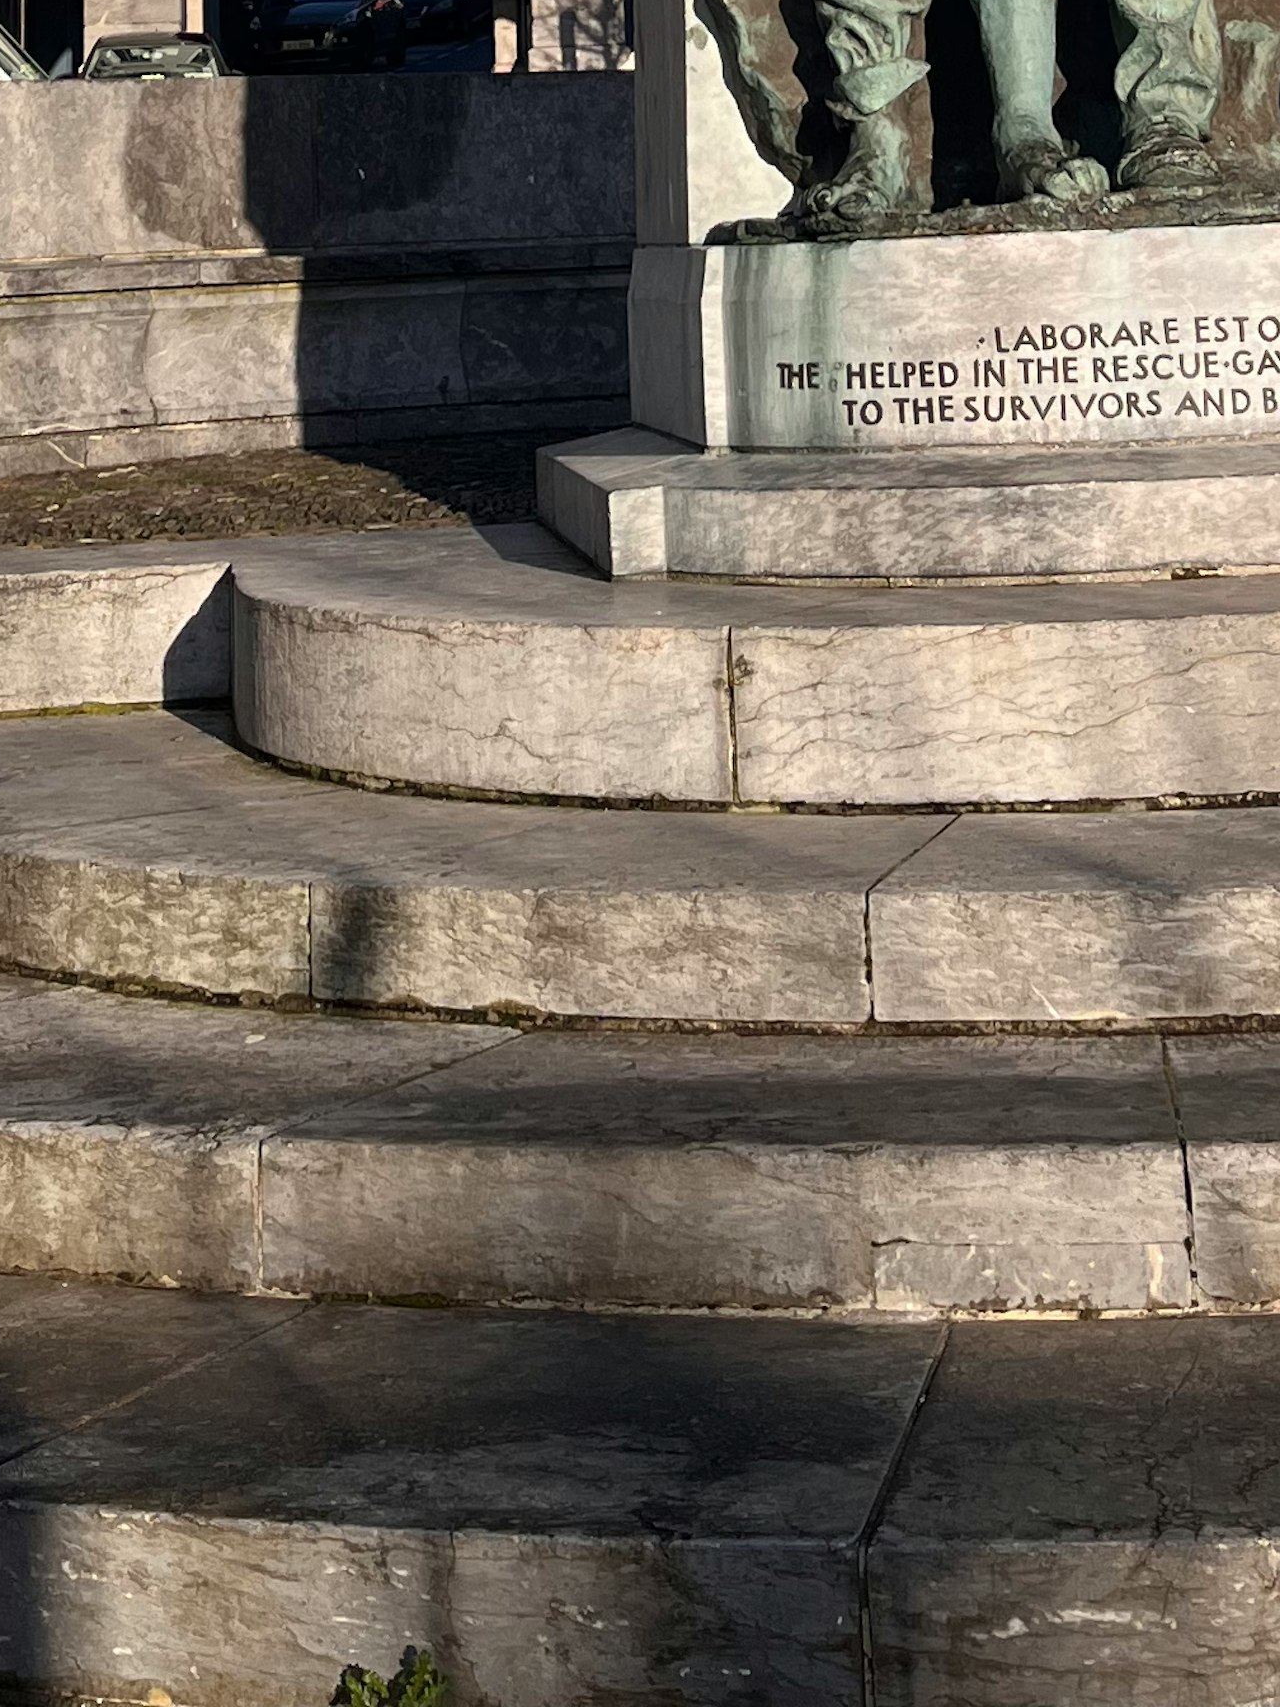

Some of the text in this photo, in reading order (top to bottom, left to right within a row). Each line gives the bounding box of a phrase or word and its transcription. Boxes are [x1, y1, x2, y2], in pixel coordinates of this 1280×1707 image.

[994, 318, 1179, 353] LABORARE
[1194, 316, 1249, 344] EST
[846, 360, 959, 389] HELPED
[974, 358, 1006, 387] IN
[1017, 356, 1079, 384] THE
[842, 399, 883, 426] TO
[893, 396, 955, 424] THE
[964, 390, 1162, 422] SURVIVORS
[1175, 388, 1251, 418] AND
